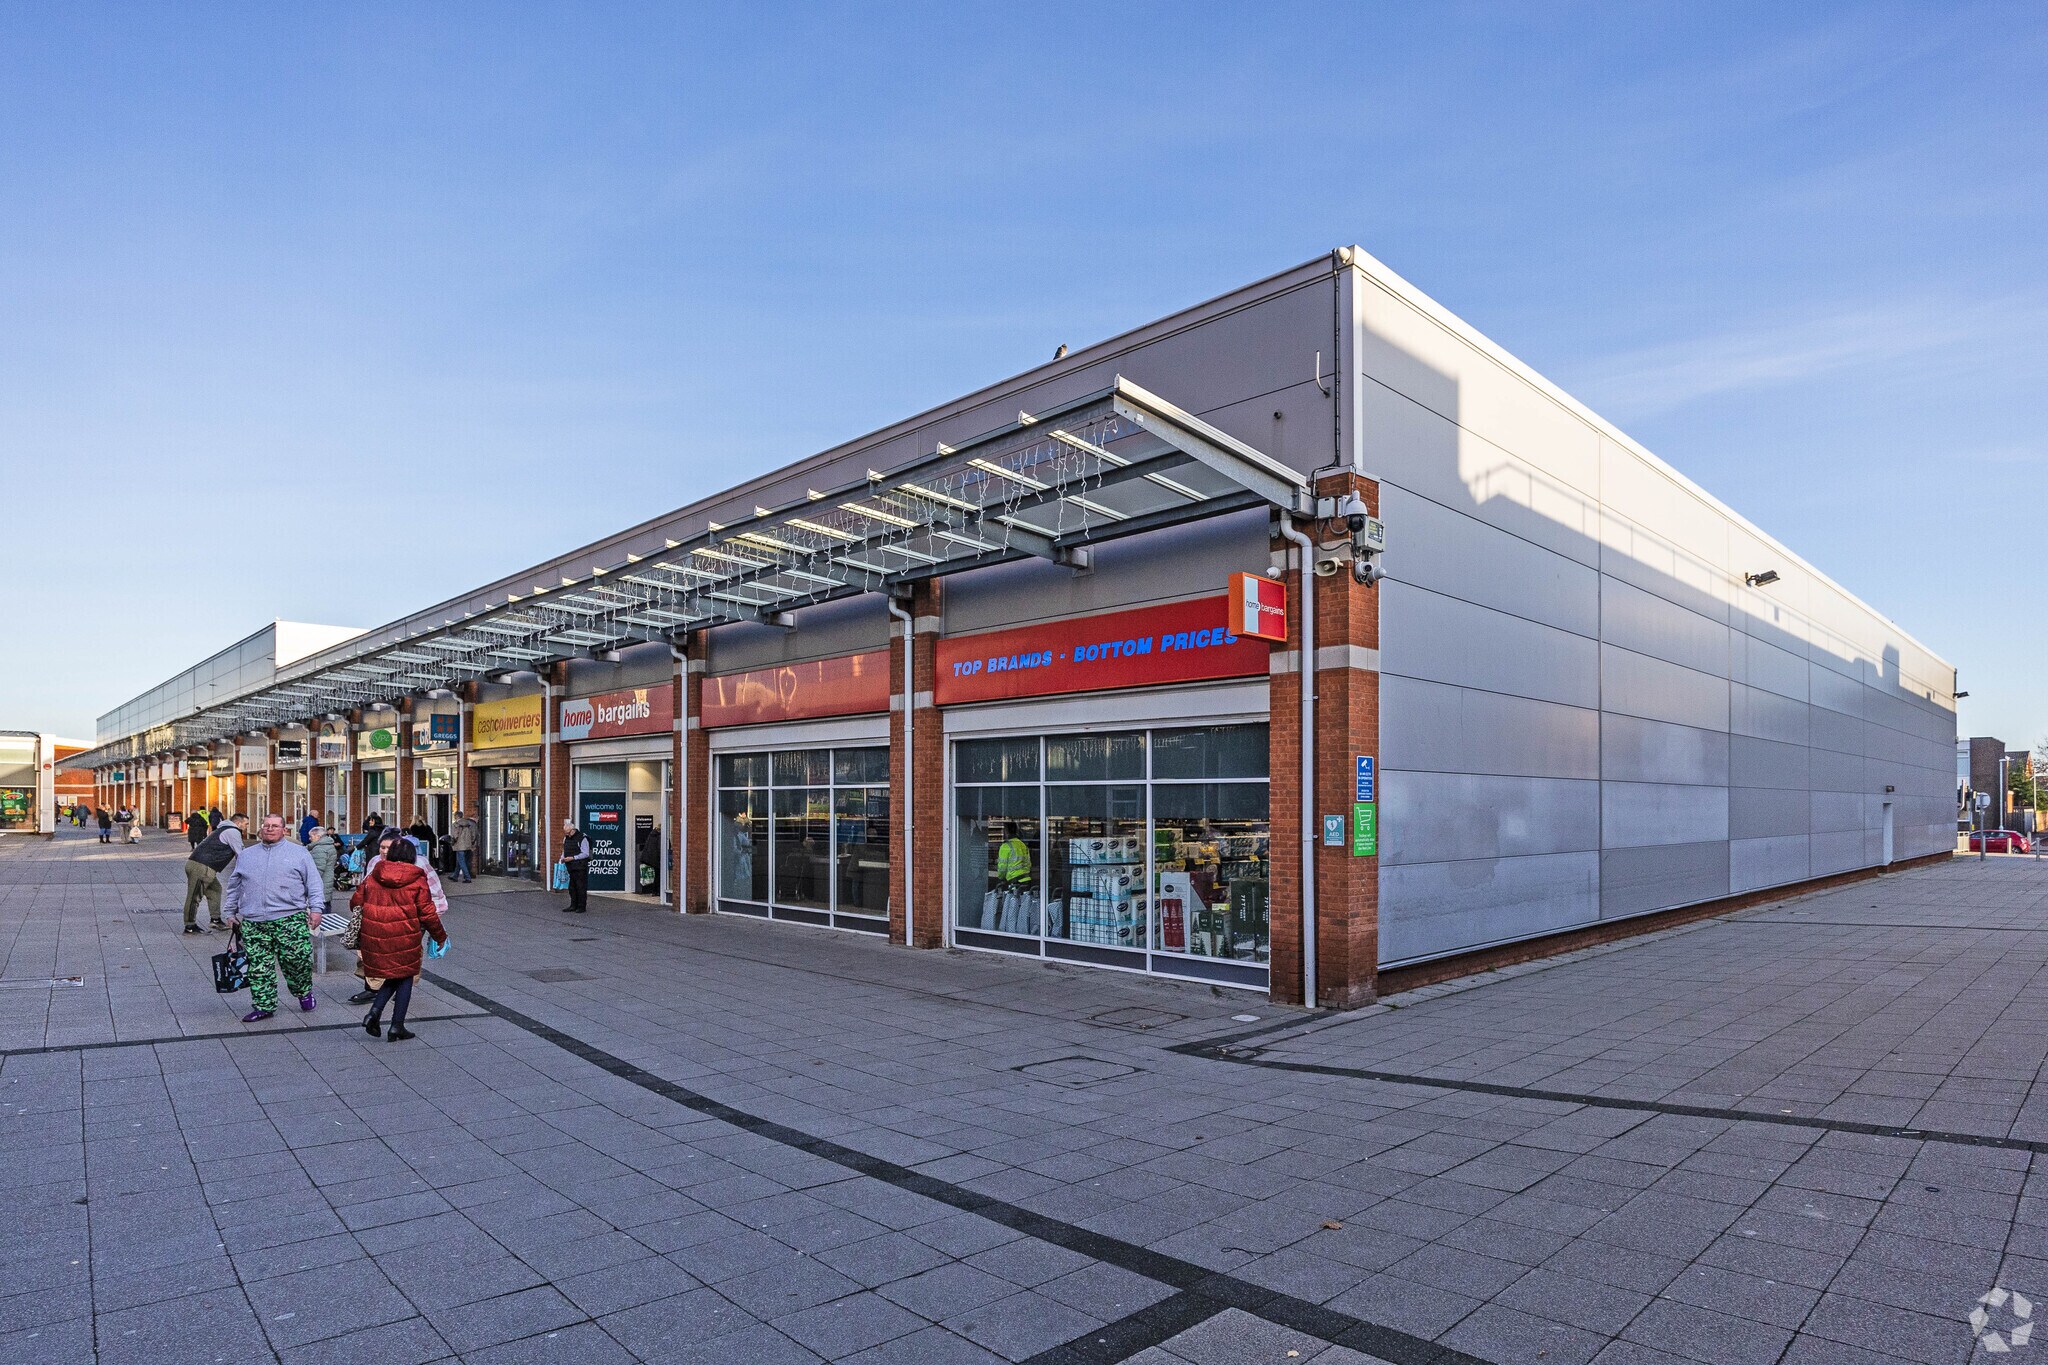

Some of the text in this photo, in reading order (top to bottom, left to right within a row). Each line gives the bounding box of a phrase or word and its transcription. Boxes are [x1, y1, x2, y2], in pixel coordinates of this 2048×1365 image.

[1246, 600, 1284, 615] home bargains
[953, 660, 982, 677] TOP
[987, 650, 1052, 673] BRANDS
[1073, 636, 1151, 663] BOTTOM
[1160, 627, 1238, 652] PRICES
[563, 698, 650, 728] home bargains
[478, 712, 541, 734] cashconverters
[595, 839, 613, 848] TOP
[592, 847, 622, 856] RANDS
[588, 866, 619, 875] PRICES
